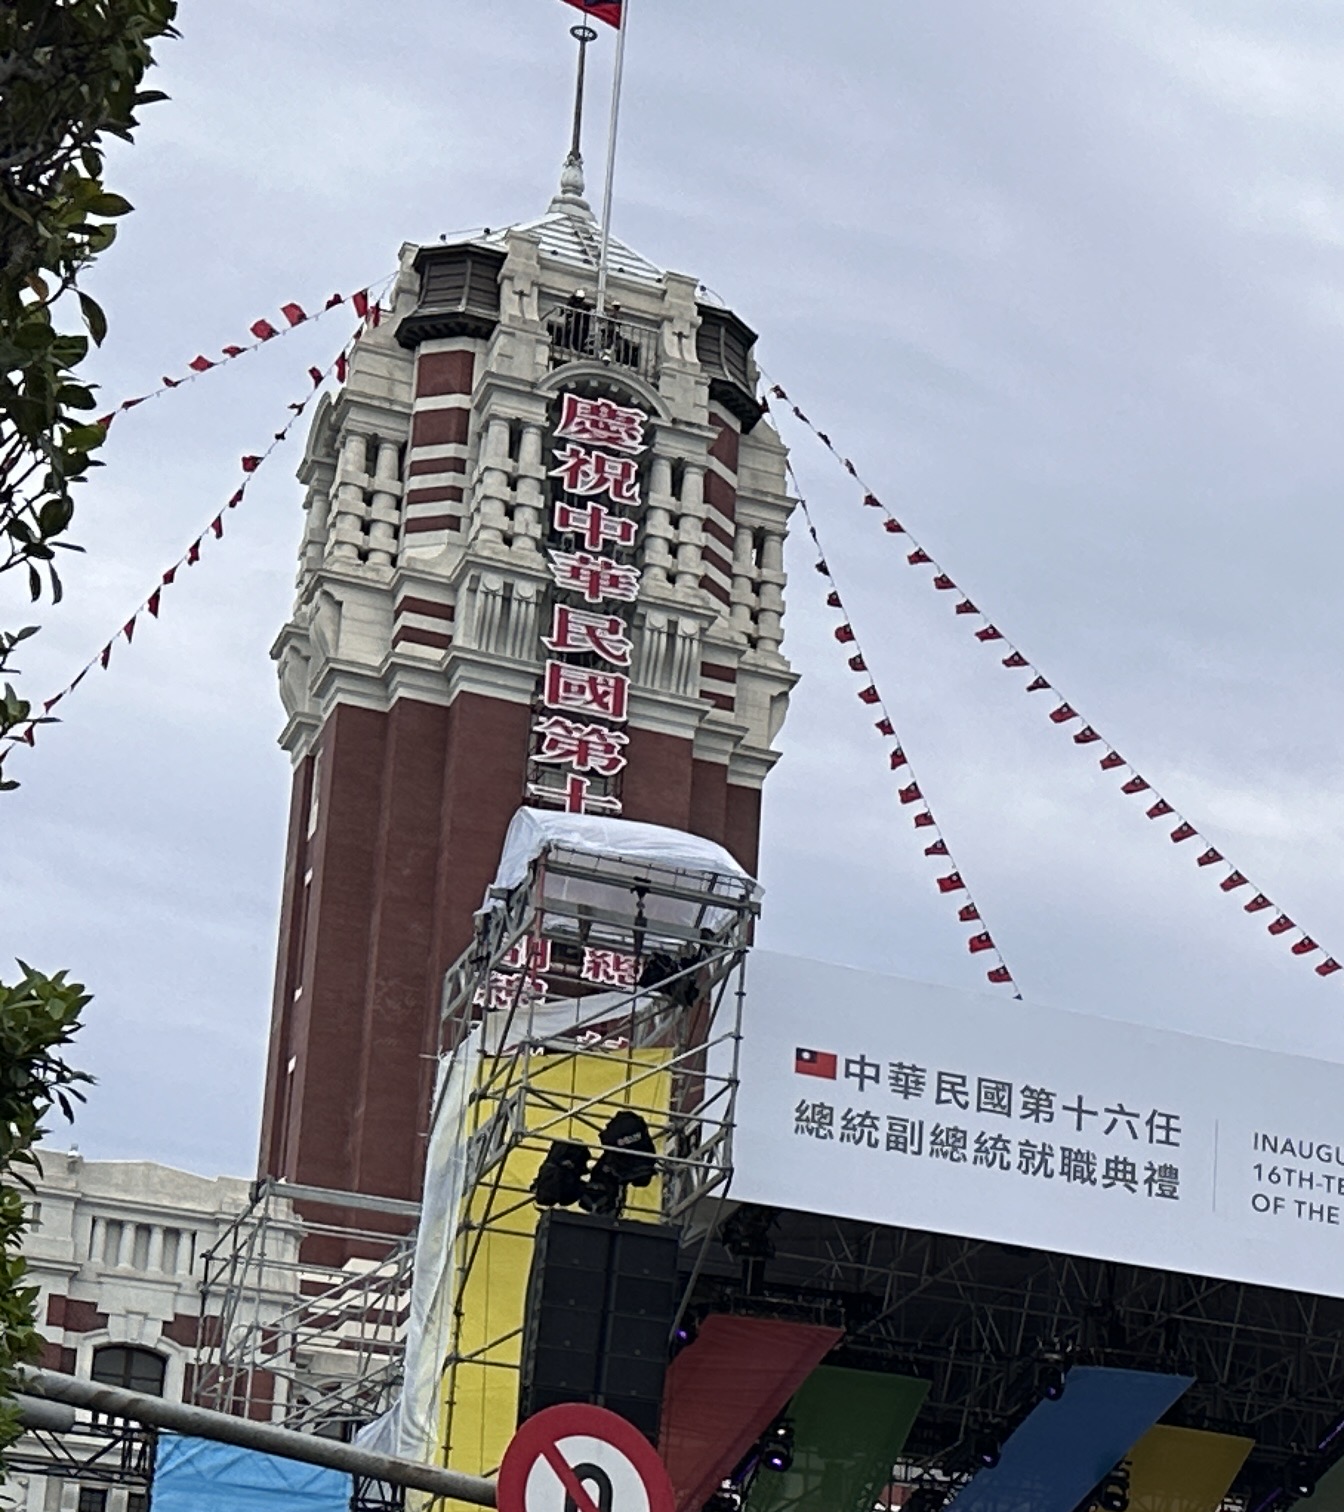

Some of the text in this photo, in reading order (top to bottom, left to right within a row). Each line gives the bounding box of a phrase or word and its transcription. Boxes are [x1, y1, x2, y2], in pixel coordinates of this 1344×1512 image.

[843, 1054, 1182, 1148] 中華民國第十六任
[793, 1099, 1181, 1201] 總統副總統就職典禮
[1251, 1193, 1286, 1216] OF
[1293, 1199, 1340, 1226] THE
